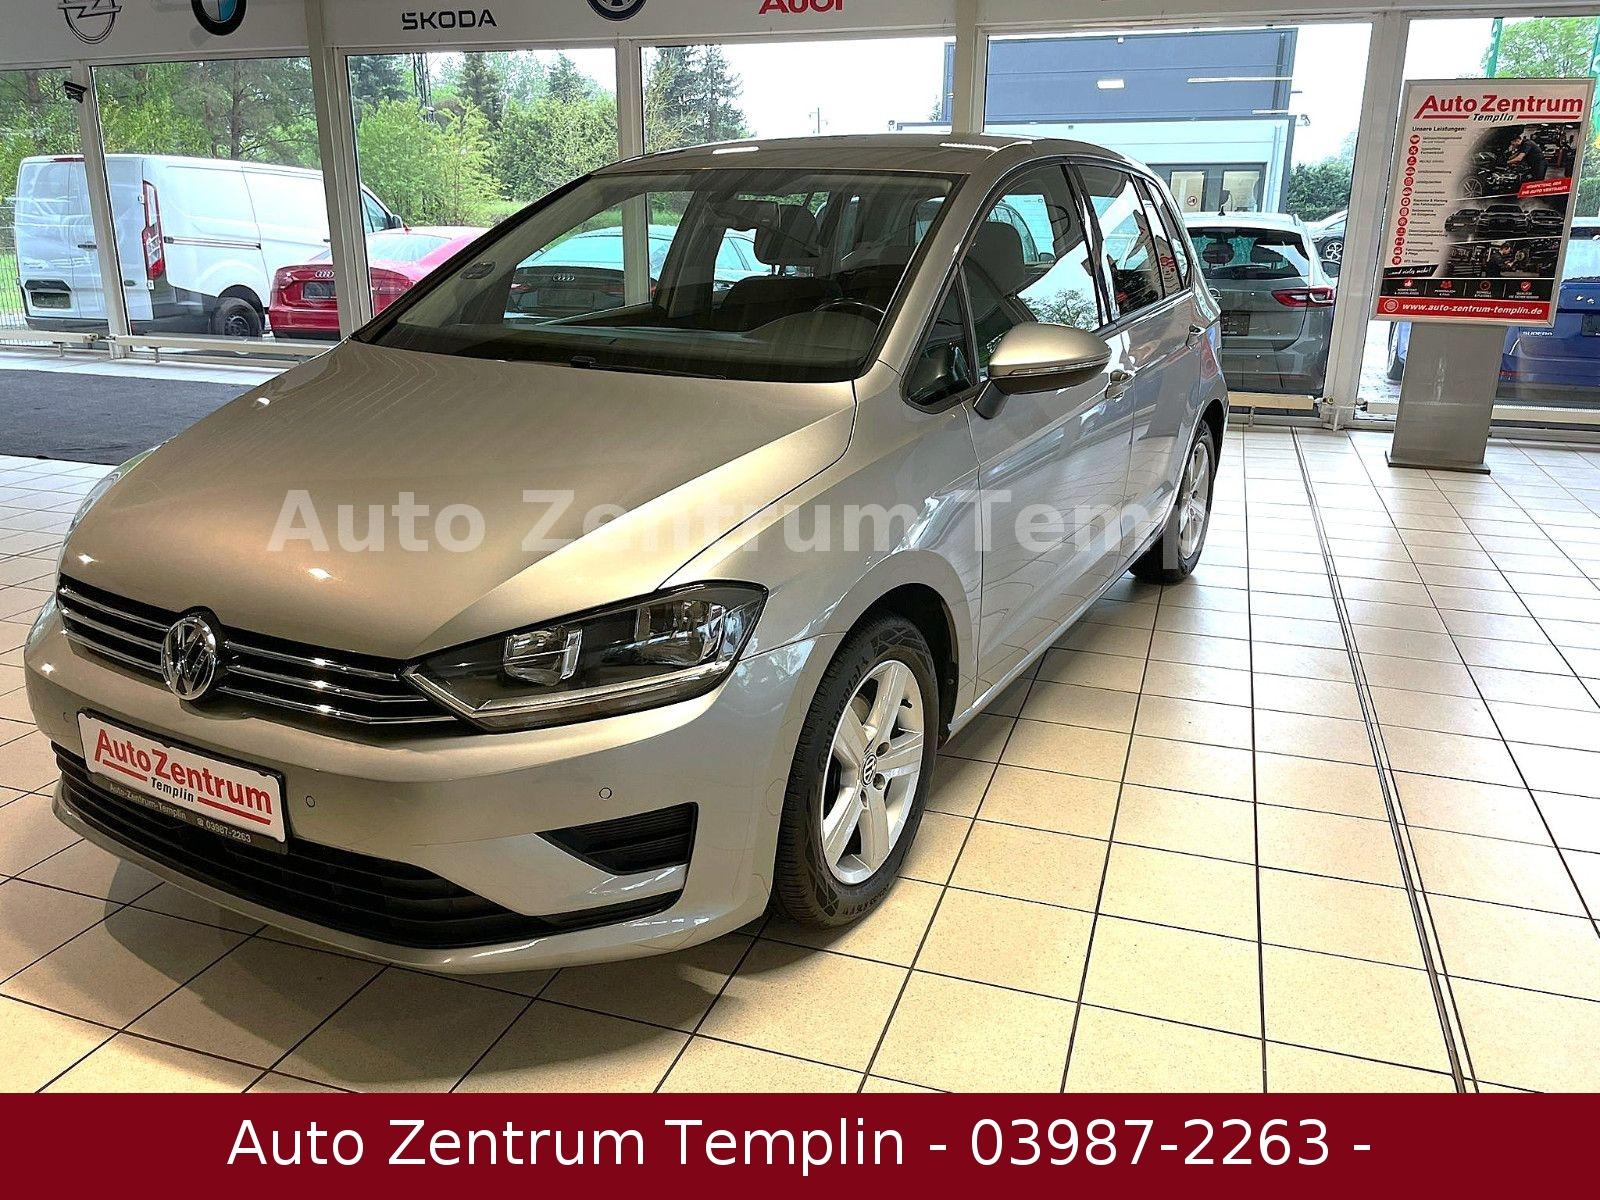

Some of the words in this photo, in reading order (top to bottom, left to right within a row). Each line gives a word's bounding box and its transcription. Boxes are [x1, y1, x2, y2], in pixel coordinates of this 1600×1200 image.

[1413, 95, 1477, 119] Auto
[1480, 95, 1583, 112] Zentrum
[1473, 113, 1513, 122] Templin
[1402, 304, 1543, 316] www.auto-zentrum-templin.de
[151, 748, 272, 815] Zentrum
[151, 776, 194, 803] Templin
[205, 819, 252, 843] 03987-2263
